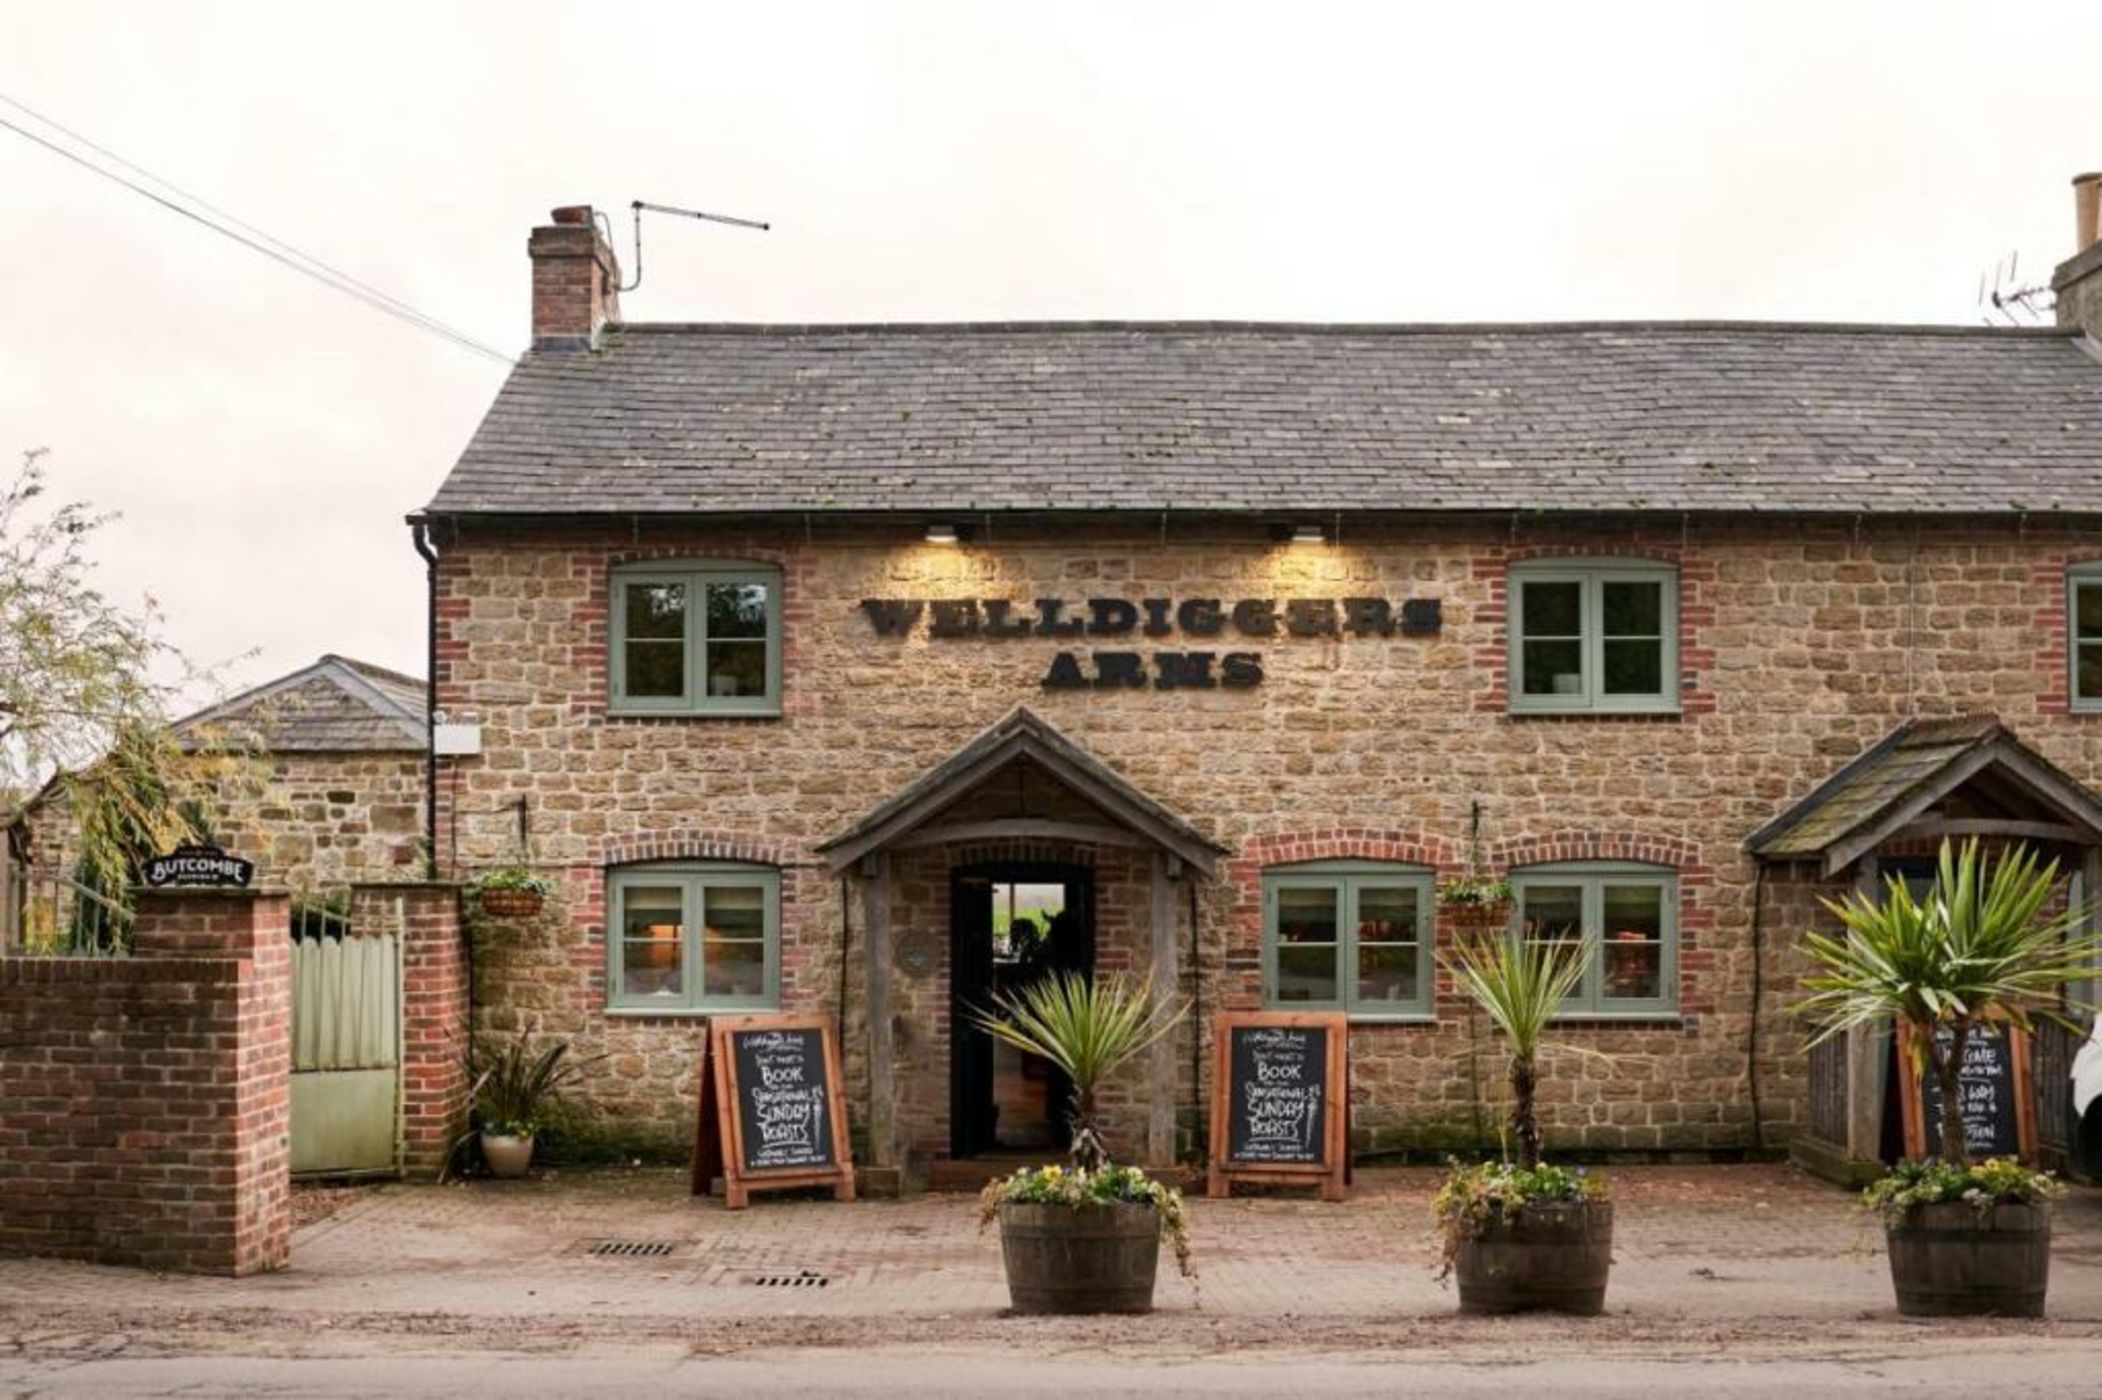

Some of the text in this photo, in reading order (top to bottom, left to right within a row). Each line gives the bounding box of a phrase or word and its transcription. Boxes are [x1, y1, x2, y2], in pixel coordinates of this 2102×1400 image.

[860, 598, 1442, 637] WELLDIGGERS
[1041, 651, 1265, 690] ARMS
[151, 859, 245, 883] BUTCOMBE
